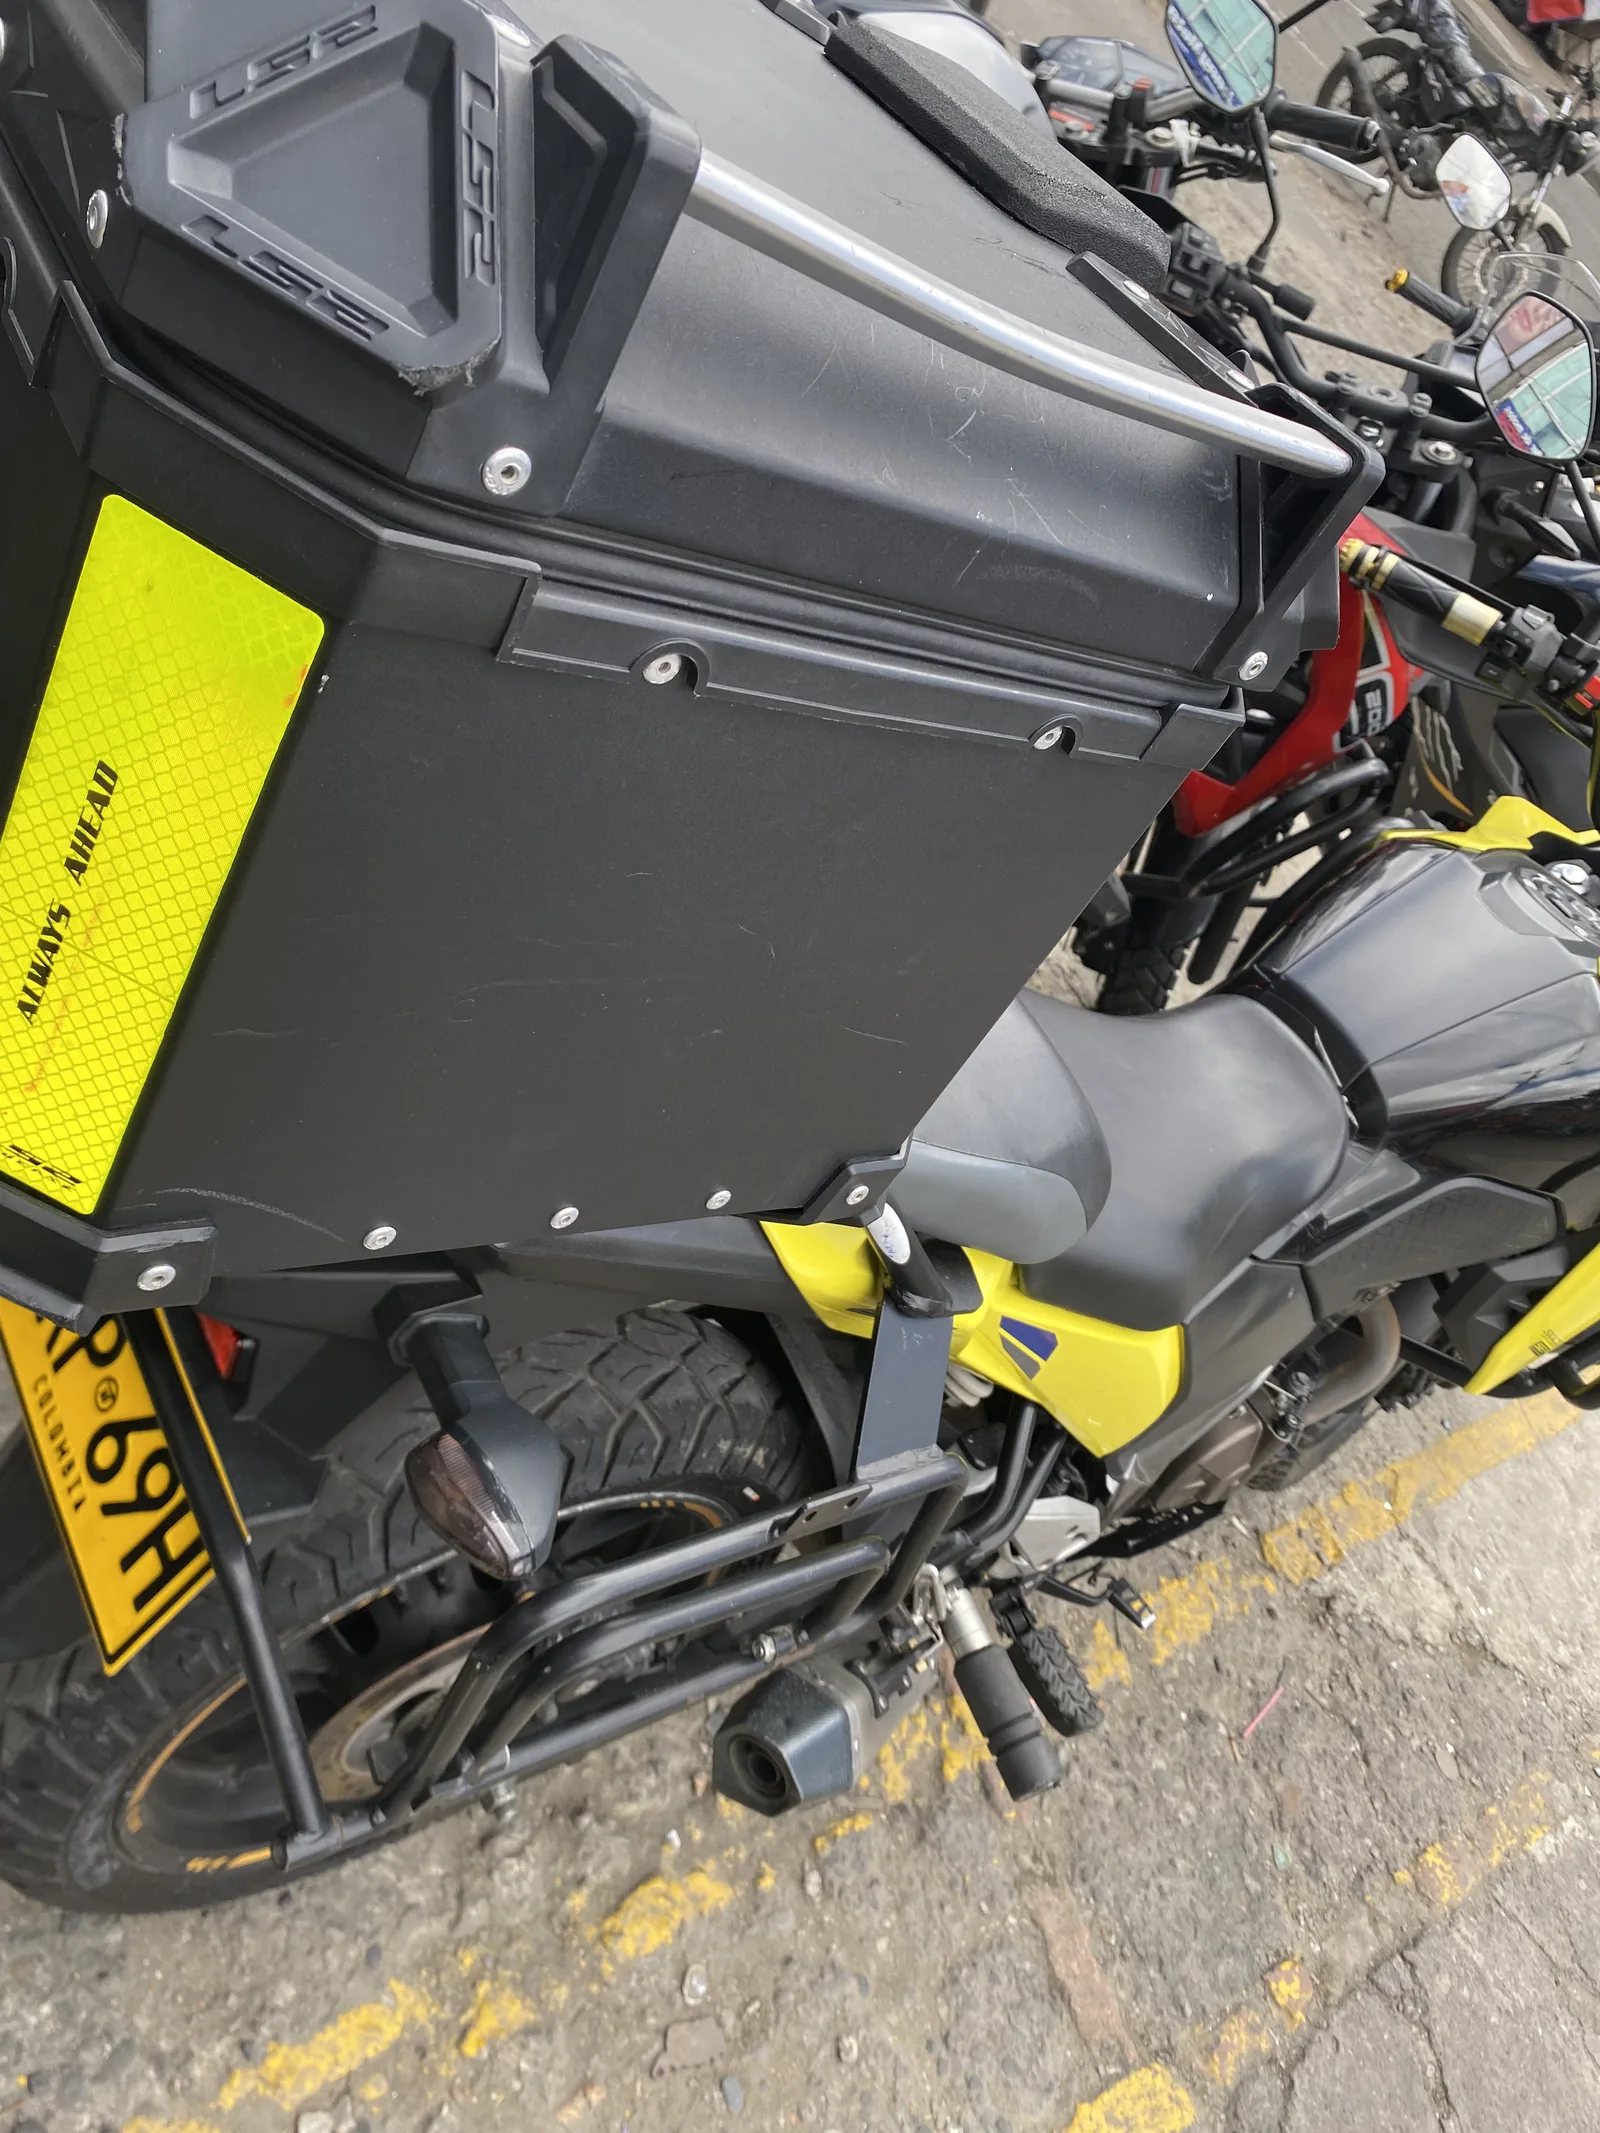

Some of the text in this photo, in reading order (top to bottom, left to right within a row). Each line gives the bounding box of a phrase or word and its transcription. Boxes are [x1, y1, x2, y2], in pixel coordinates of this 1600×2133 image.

[189, 4, 377, 120] LS2
[461, 70, 496, 287] LS2
[182, 214, 391, 342] LS2
[16, 760, 119, 1025] ALWAYS AHEAD
[33, 1373, 87, 1512] COLOMBIA
